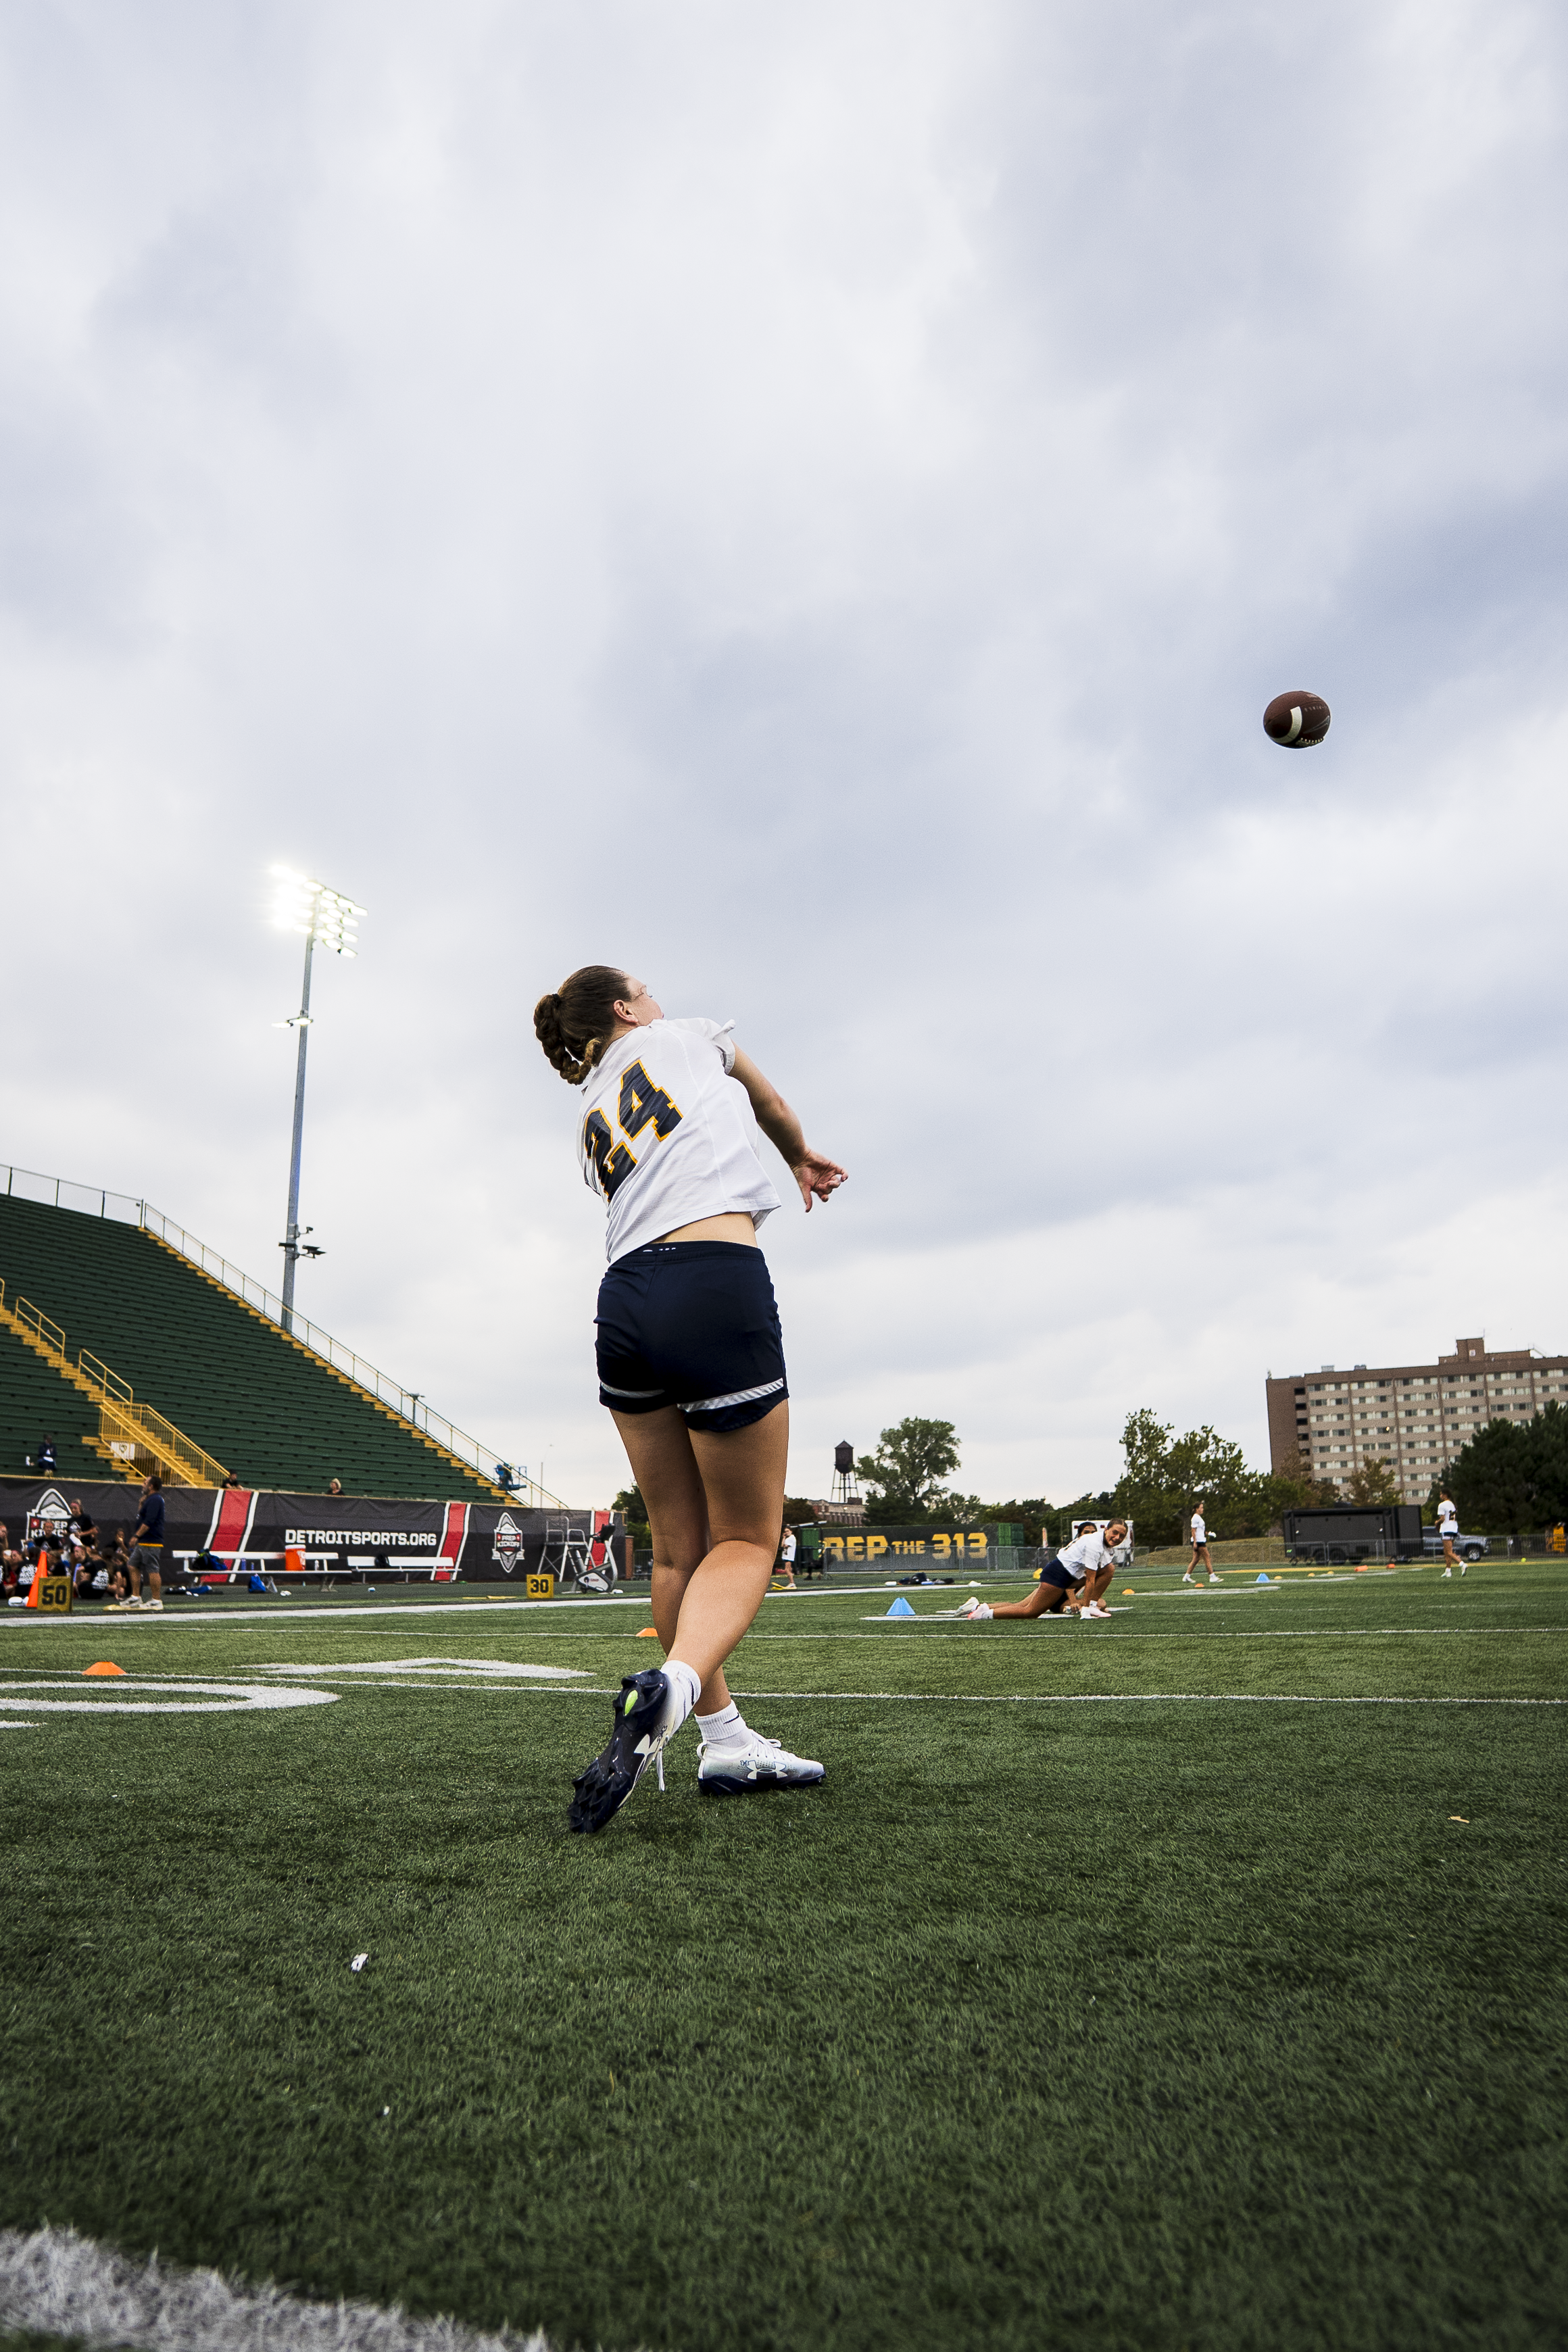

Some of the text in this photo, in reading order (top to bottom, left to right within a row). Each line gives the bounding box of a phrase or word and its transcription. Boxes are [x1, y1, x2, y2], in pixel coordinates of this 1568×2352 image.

[585, 1059, 683, 1203] 24
[285, 1529, 437, 1546] DETROITSPORTS.ORG
[823, 1532, 988, 1562] REP THE 313
[42, 1585, 68, 1604] 50
[531, 1579, 549, 1593] 30
